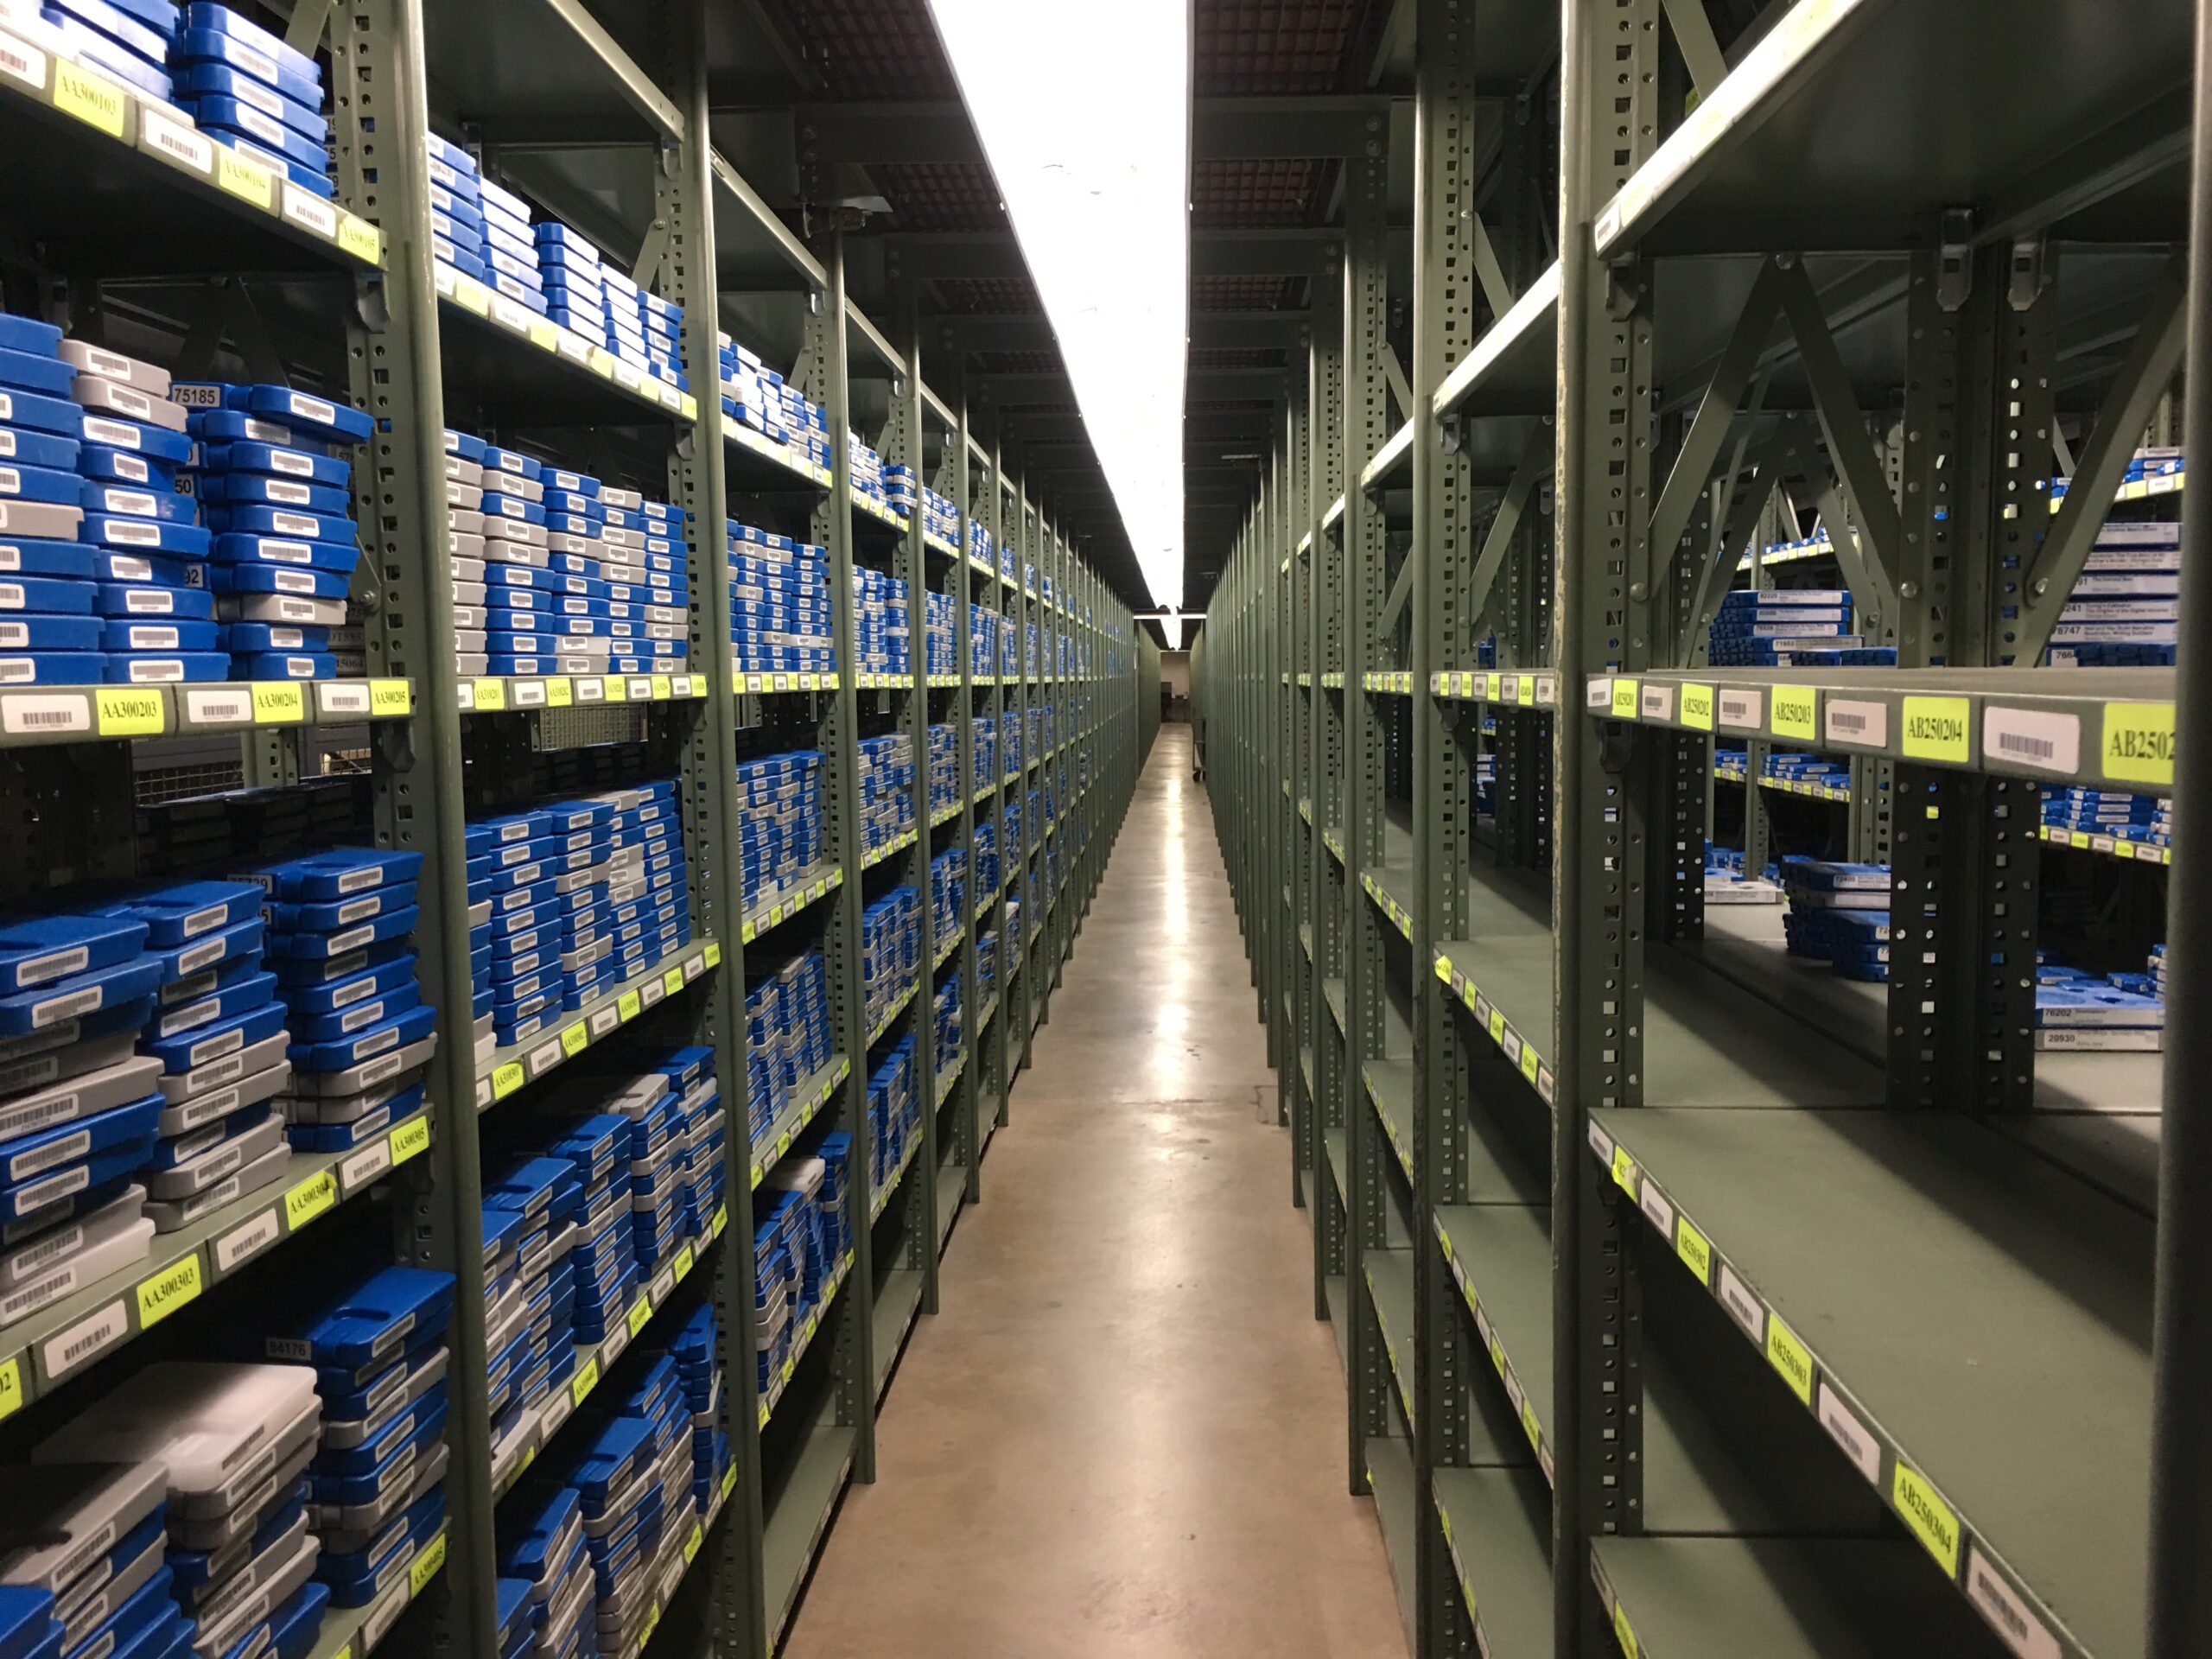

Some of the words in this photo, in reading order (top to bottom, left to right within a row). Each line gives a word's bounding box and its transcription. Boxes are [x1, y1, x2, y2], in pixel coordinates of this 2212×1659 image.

[175, 388, 215, 404] 75185
[257, 693, 298, 709] AA300204
[374, 690, 405, 705] AA300205
[1615, 692, 1634, 707] AB250201
[1683, 696, 1709, 716] AB250202
[102, 701, 157, 719] AA300203
[1774, 702, 1811, 724] AB250203
[1908, 716, 1963, 742] AB250204
[143, 1267, 194, 1313] AA300303
[1771, 1333, 1807, 1387] AB250303
[1898, 1476, 1952, 1554] AB250304
